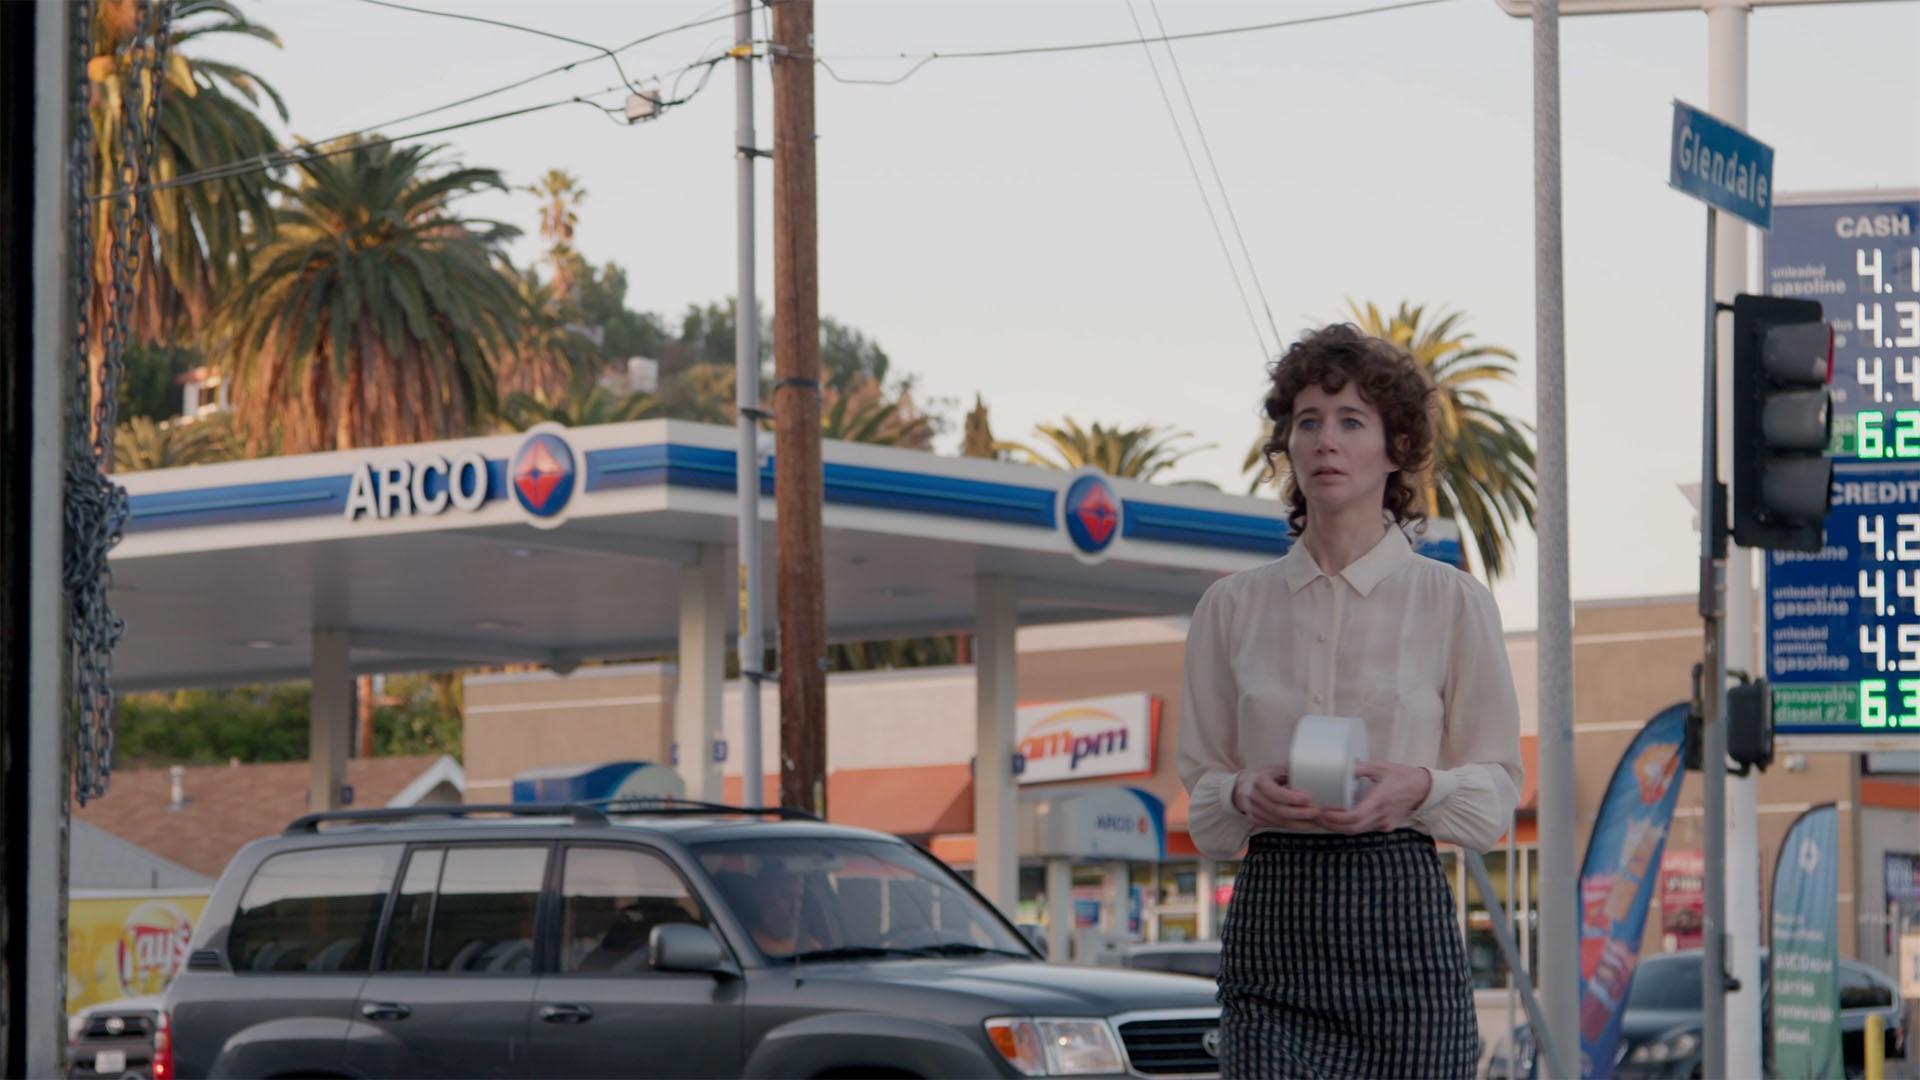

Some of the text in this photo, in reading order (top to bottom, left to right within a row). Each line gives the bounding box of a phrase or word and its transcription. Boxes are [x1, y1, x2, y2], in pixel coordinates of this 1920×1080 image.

[1678, 125, 1769, 209] Glendale
[1835, 214, 1911, 238] CASH
[1771, 264, 1826, 279] unleaded
[1771, 278, 1847, 297] gasoline
[1856, 301, 1920, 349] 4.3
[1856, 356, 1920, 403] 4.4
[1856, 409, 1920, 459] 6.2
[344, 451, 489, 522] ARCO
[1830, 480, 1920, 506] CREDIT
[1857, 514, 1920, 562] 4.2
[1772, 585, 1856, 602] unleaded plus
[1858, 568, 1920, 617] 4.4
[1772, 599, 1850, 620] gasoline
[1773, 626, 1829, 641] unleaded
[1773, 641, 1828, 655] premium
[1859, 624, 1920, 672] 4.5
[1773, 655, 1850, 675] gasoline
[1773, 686, 1857, 704] renewable
[1860, 679, 1920, 728] 6.3
[1773, 704, 1847, 722] diesel #2
